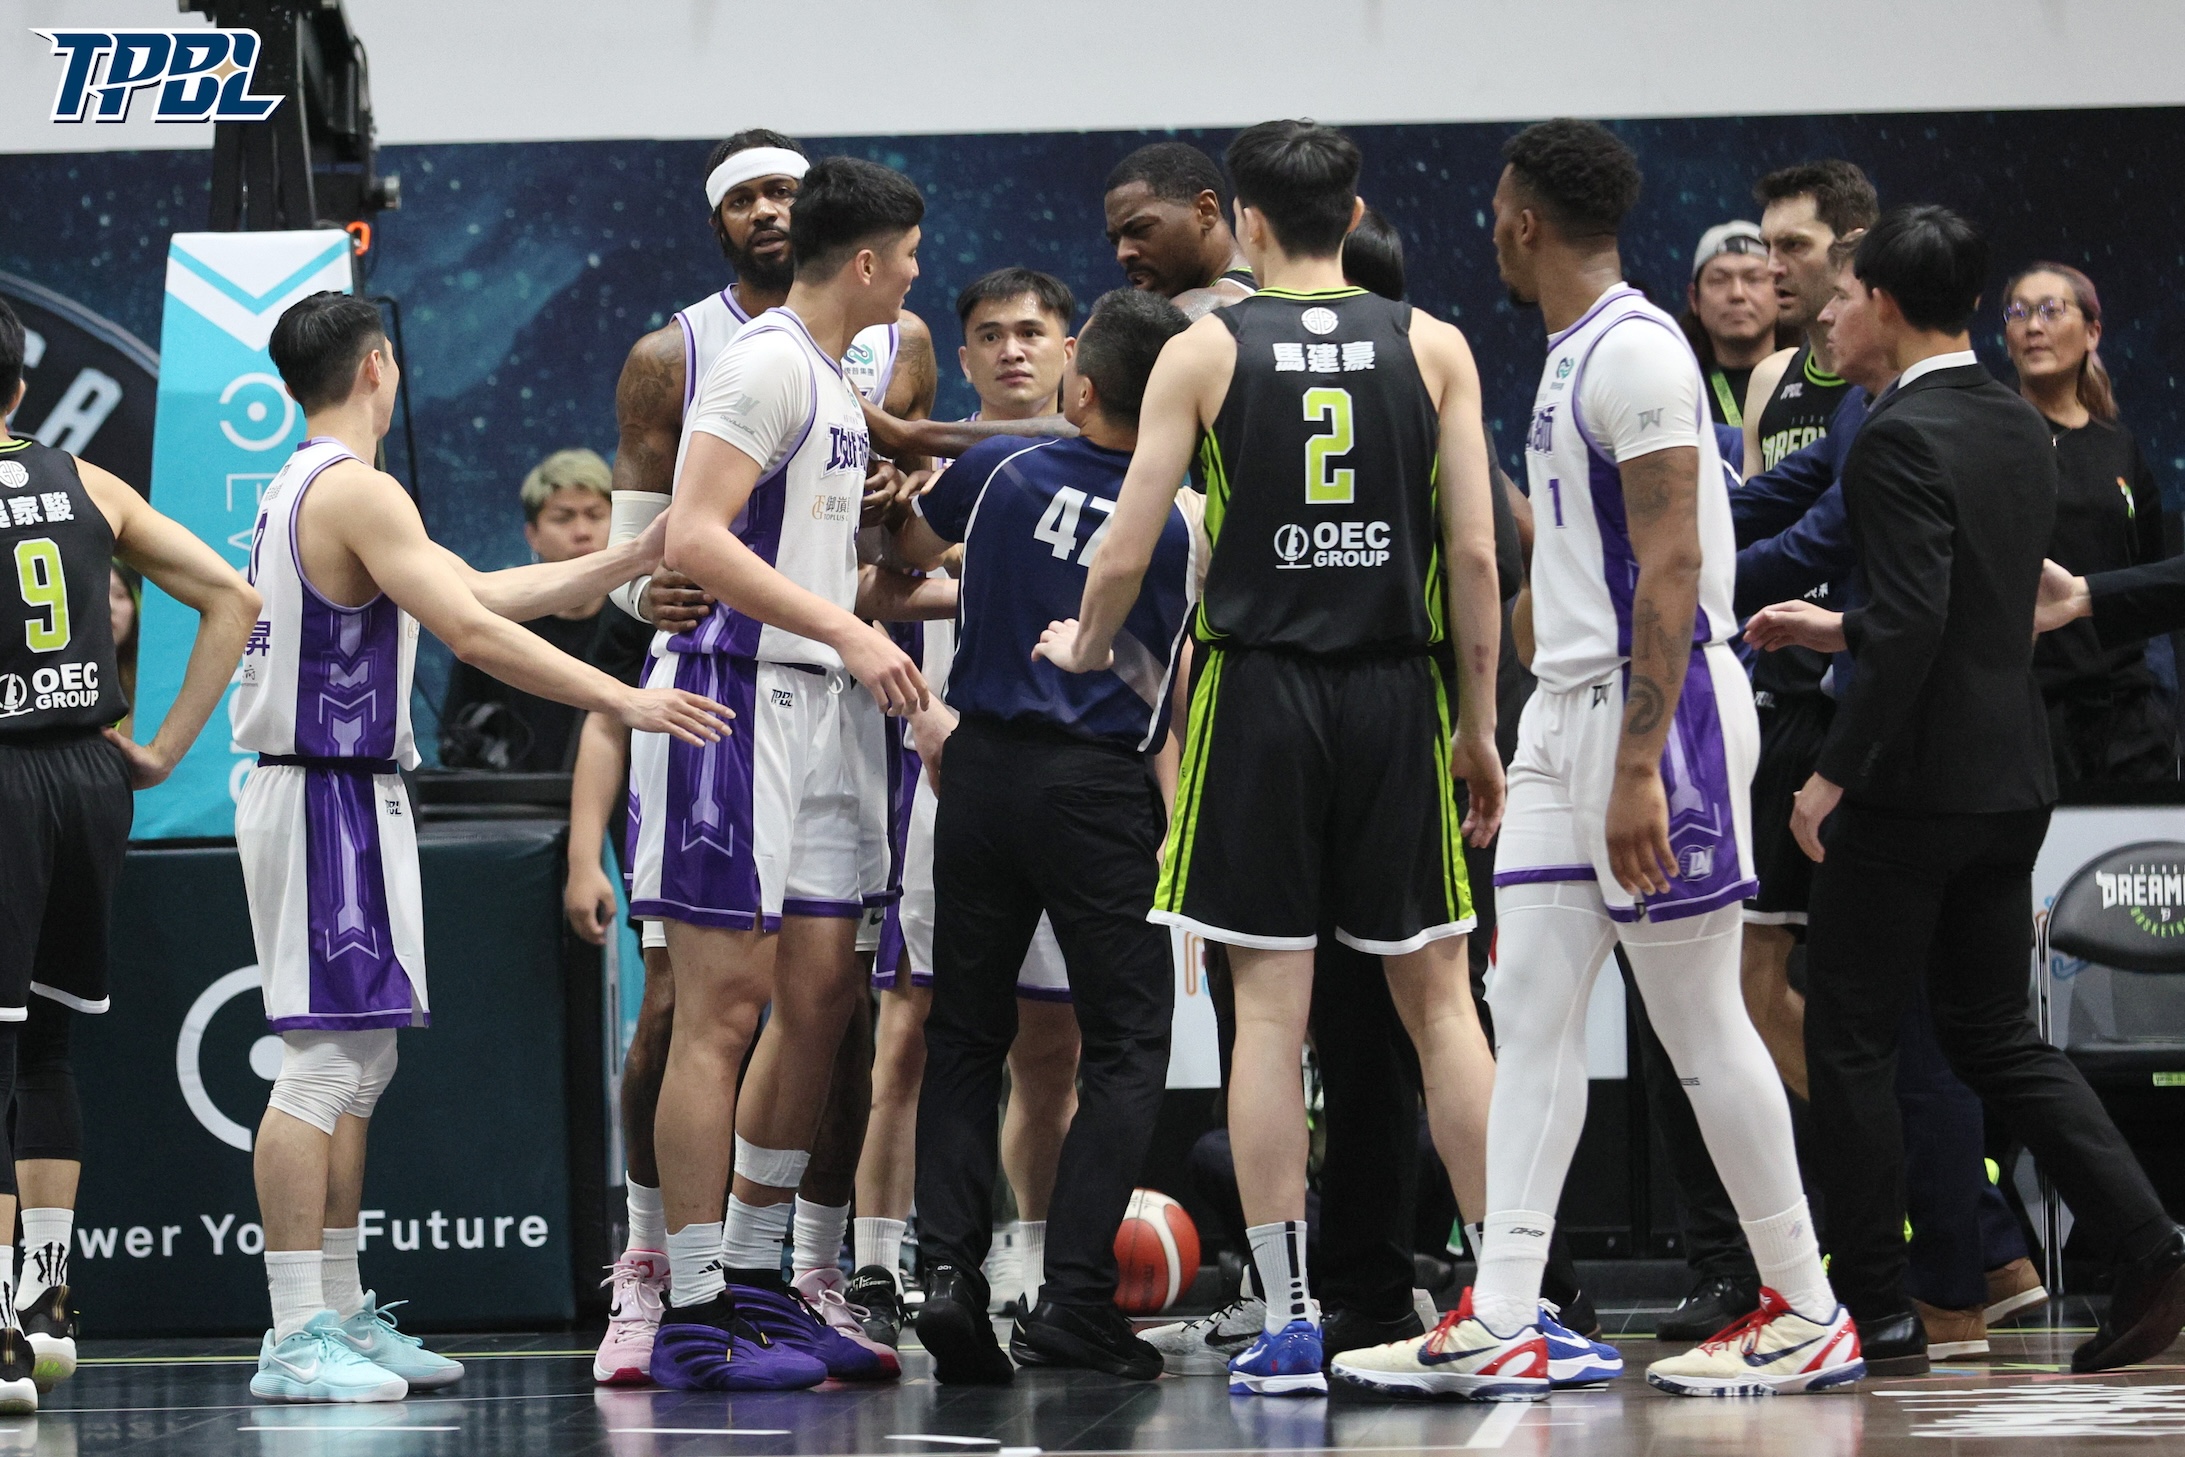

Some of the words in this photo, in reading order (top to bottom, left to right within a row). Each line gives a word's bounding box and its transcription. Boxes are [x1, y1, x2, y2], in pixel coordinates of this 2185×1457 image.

[1273, 341, 1375, 373] 馬建豪
[1303, 387, 1355, 504] 2
[1547, 478, 1567, 529] 1
[1313, 521, 1391, 550] OEC
[1313, 550, 1390, 568] GROUP
[14, 537, 71, 653] 9
[243, 620, 271, 657] 昇
[32, 662, 99, 694] OEC
[35, 690, 99, 710] GROUP
[2096, 870, 2185, 910] DREAM
[19, 1224, 182, 1260] wer
[200, 1213, 265, 1256] Yo
[357, 1209, 549, 1252] Future
